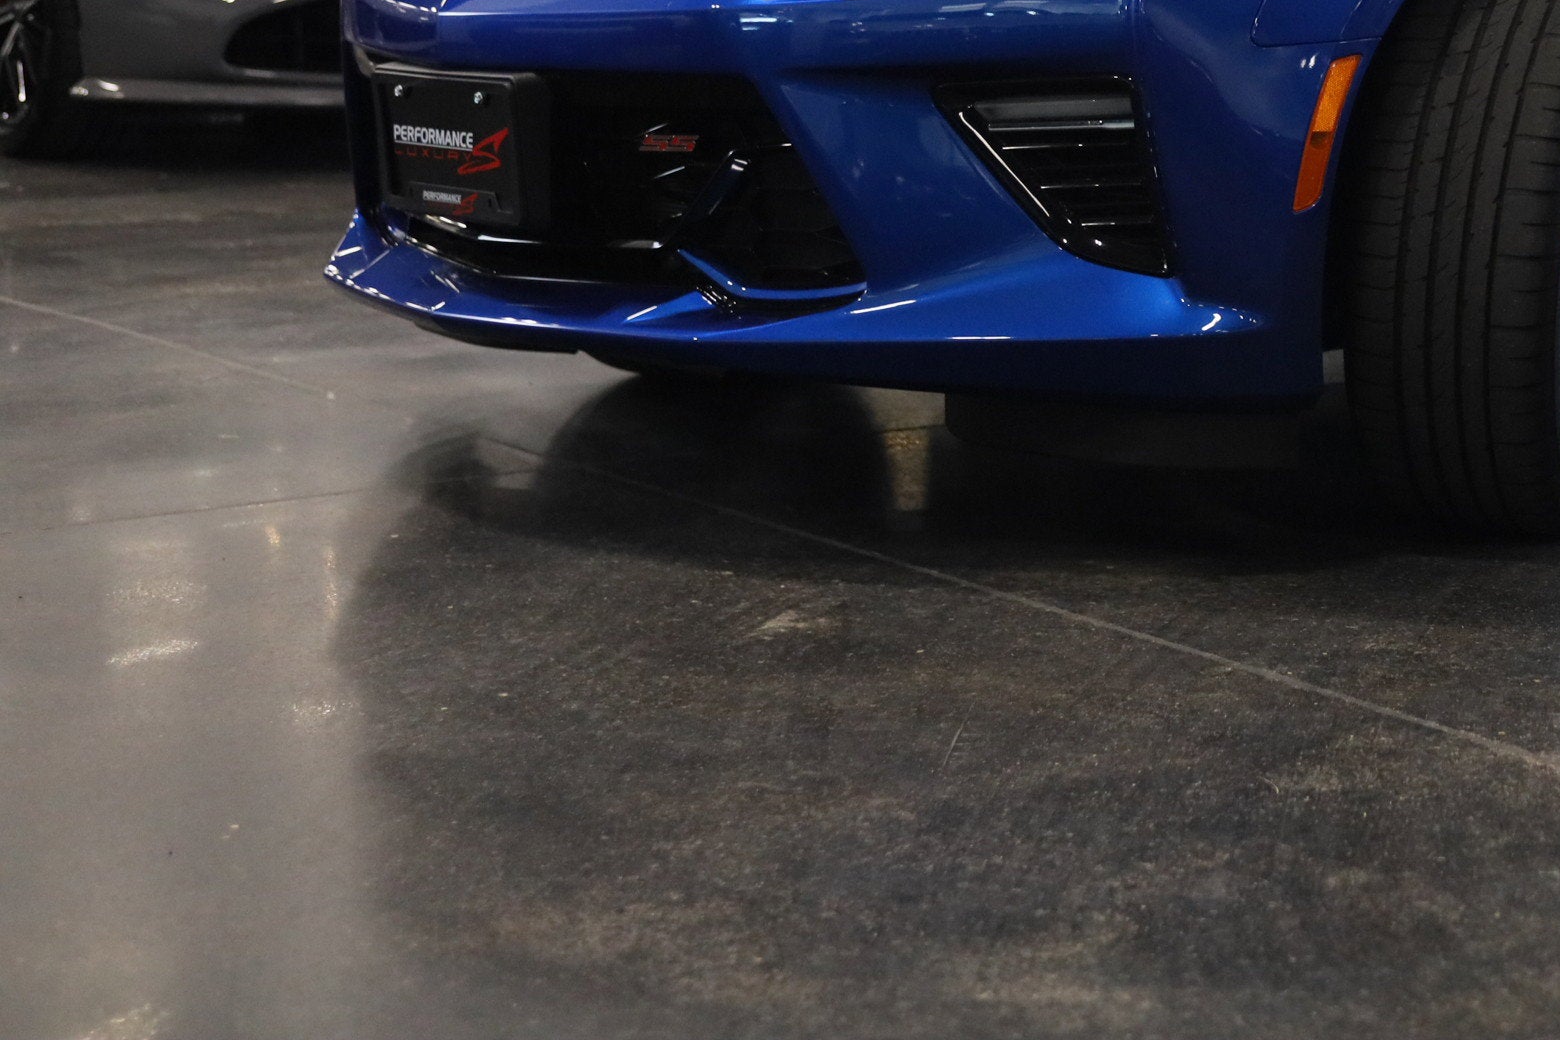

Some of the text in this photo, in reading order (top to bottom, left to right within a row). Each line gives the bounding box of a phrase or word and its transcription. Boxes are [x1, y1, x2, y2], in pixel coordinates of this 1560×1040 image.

[393, 124, 474, 149] PERFORMANCE
[639, 134, 700, 152] SS
[422, 190, 462, 205] PERFORMANCE
